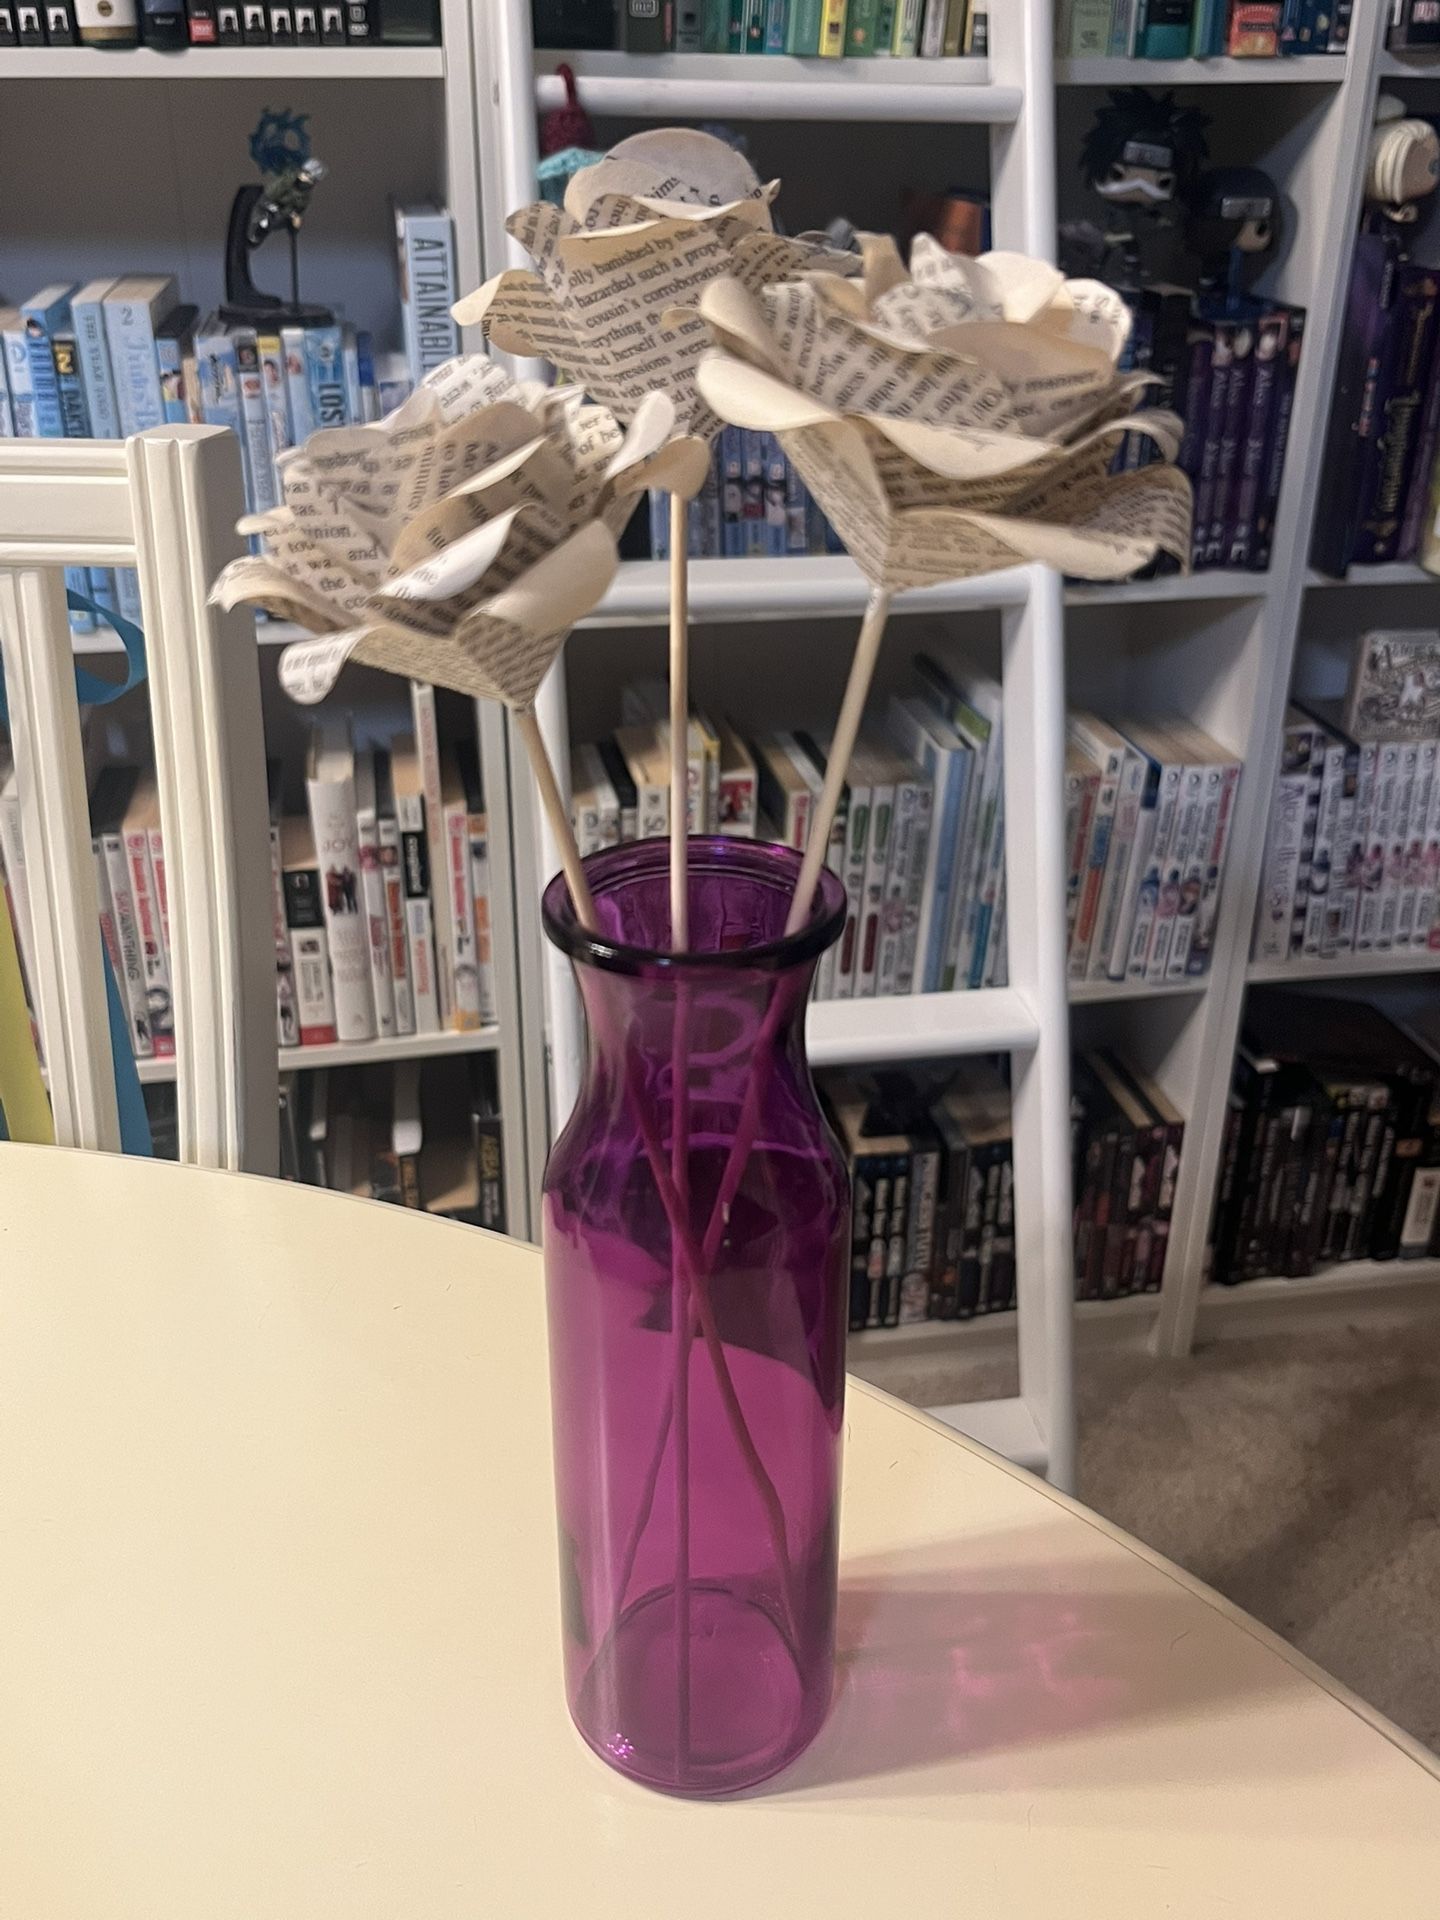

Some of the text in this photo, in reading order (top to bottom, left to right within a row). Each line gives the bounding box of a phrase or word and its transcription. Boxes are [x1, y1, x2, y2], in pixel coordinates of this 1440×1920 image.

[575, 272, 636, 308] hazarded
[637, 260, 670, 281] such
[672, 256, 683, 268] a
[414, 238, 452, 370] ATTAINABL
[586, 298, 641, 329] cousin's
[611, 333, 658, 362] herself
[660, 331, 676, 344] in
[677, 337, 712, 358] were
[647, 375, 669, 391] the
[348, 548, 378, 561] and
[320, 577, 346, 592] the
